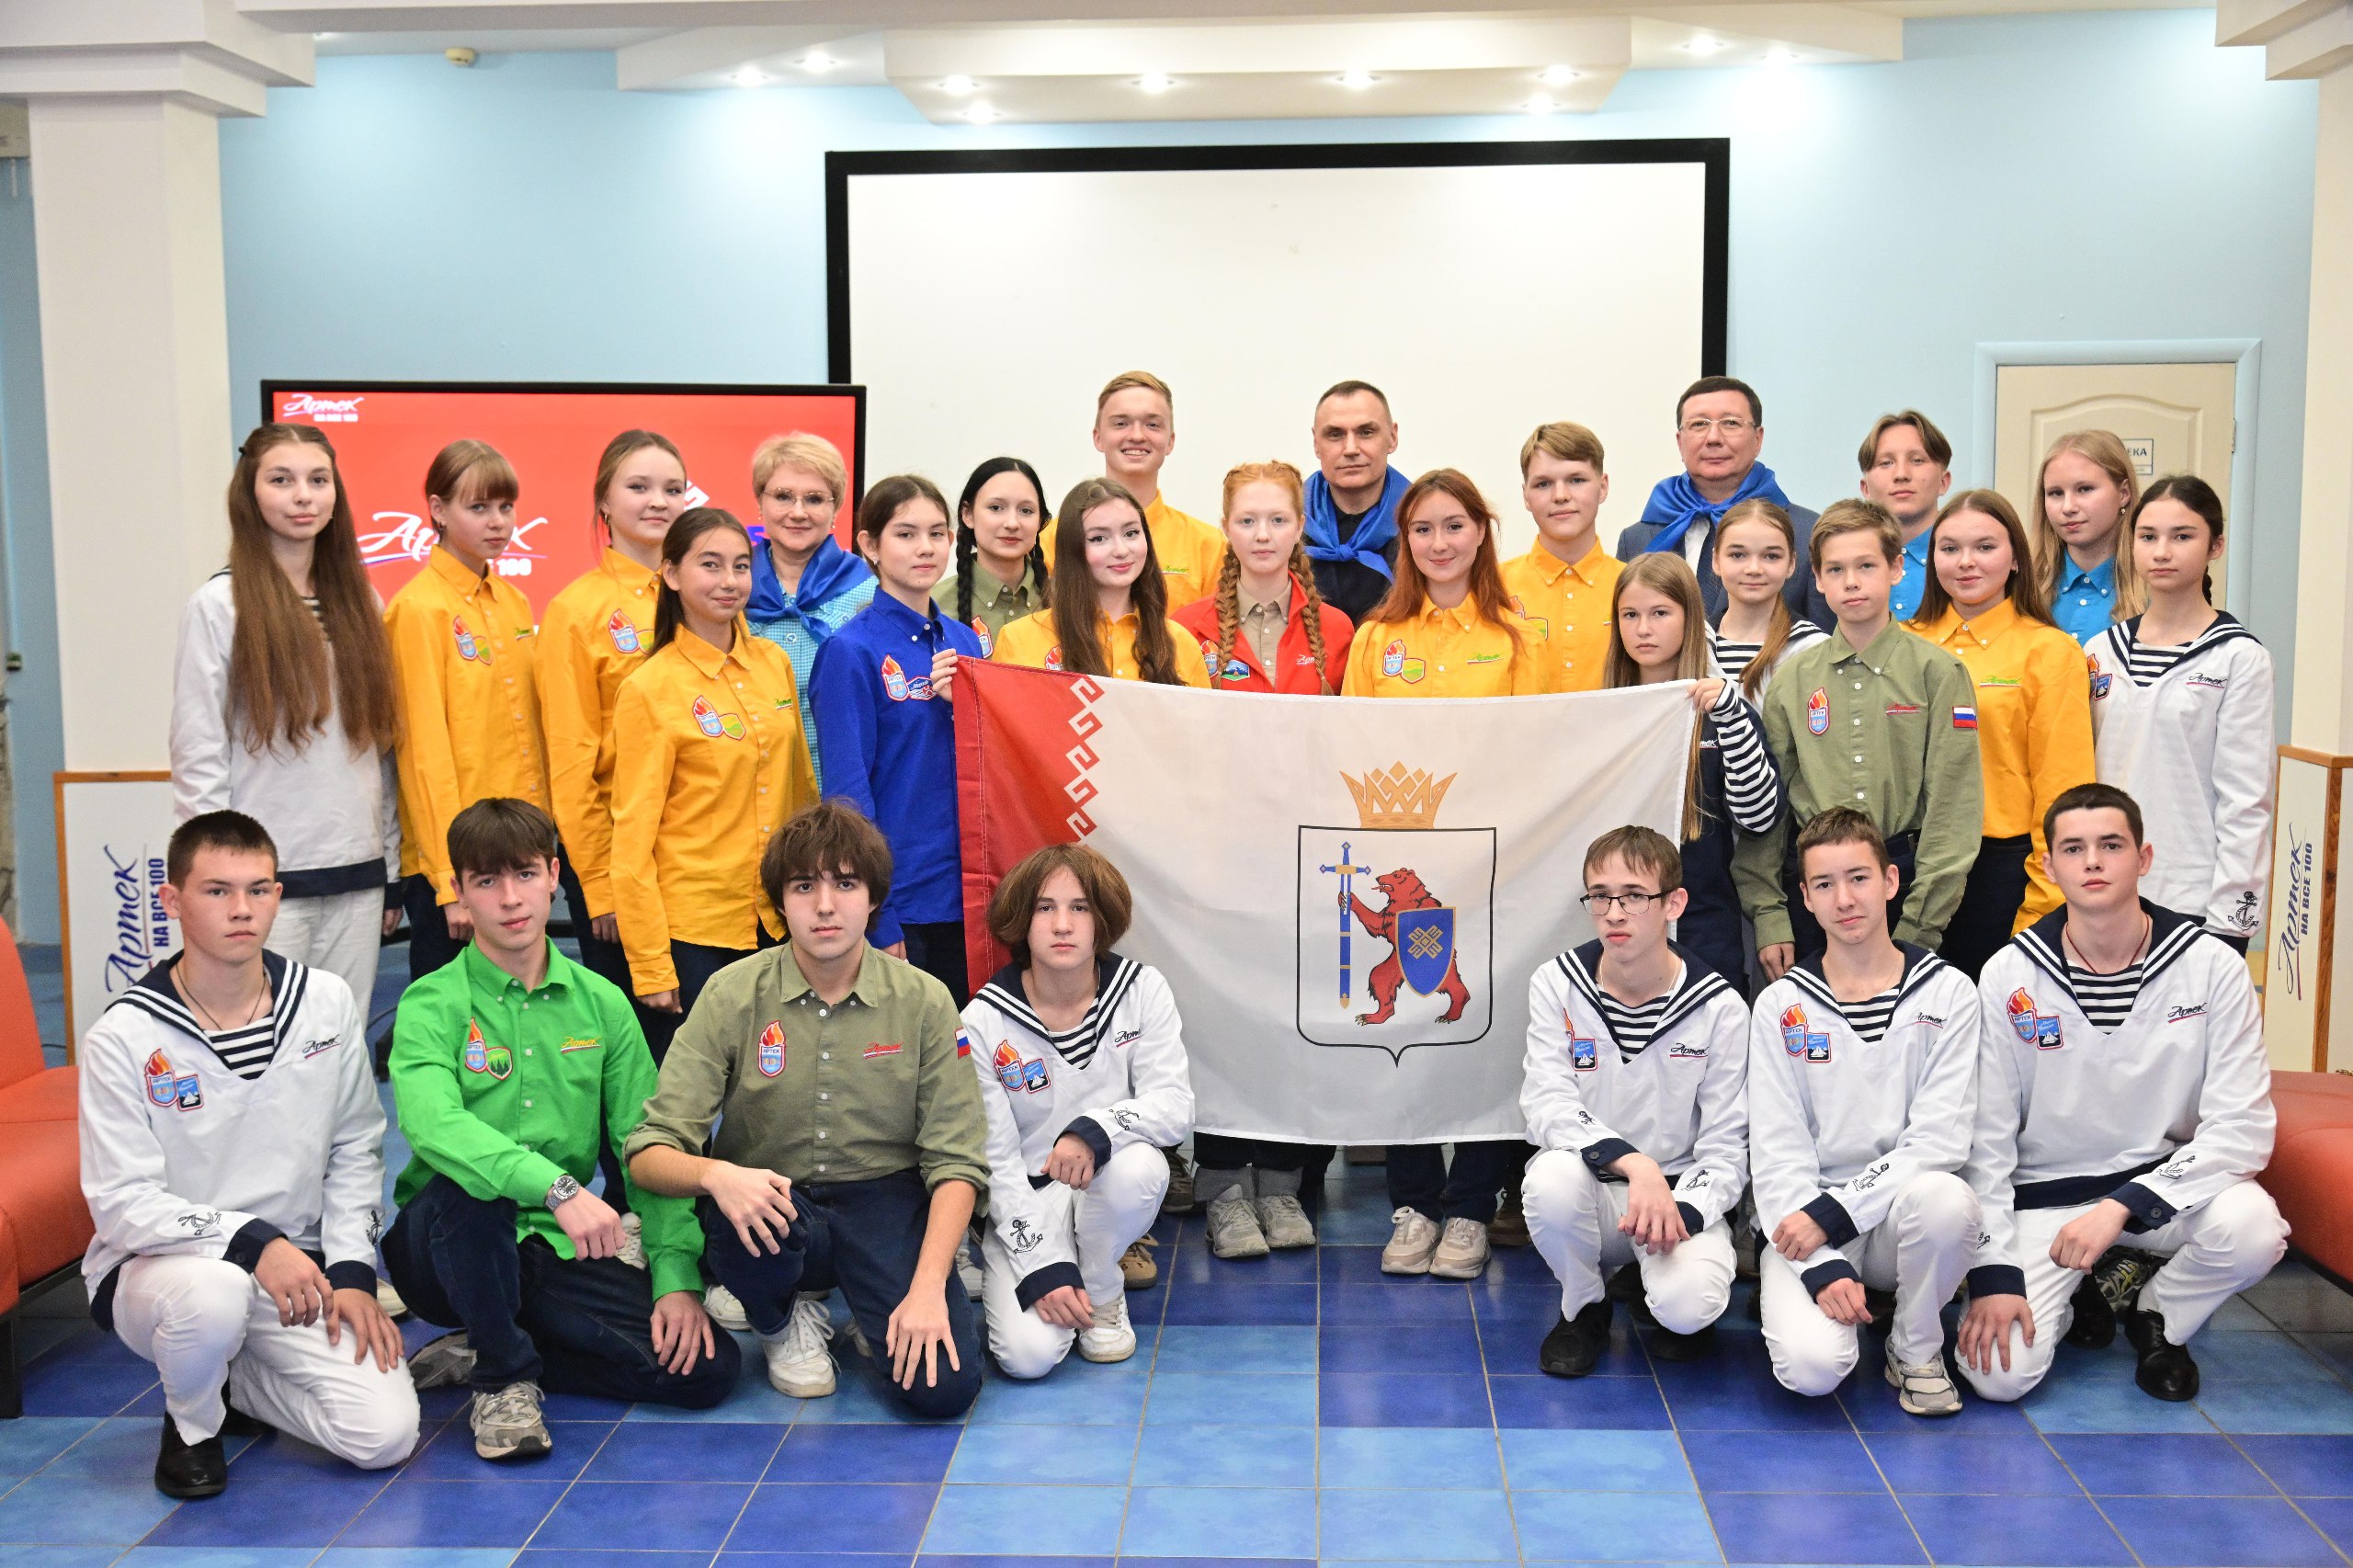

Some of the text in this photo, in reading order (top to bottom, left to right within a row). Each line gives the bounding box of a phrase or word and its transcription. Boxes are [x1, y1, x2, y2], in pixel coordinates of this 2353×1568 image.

[496, 557, 532, 576] 100
[147, 858, 165, 886] 100
[2300, 842, 2313, 936] НА ВСЕ 100
[103, 844, 153, 993] Артек
[2278, 822, 2302, 994] Артек
[152, 926, 170, 948] НА
[1114, 1028, 1141, 1042] Арт
